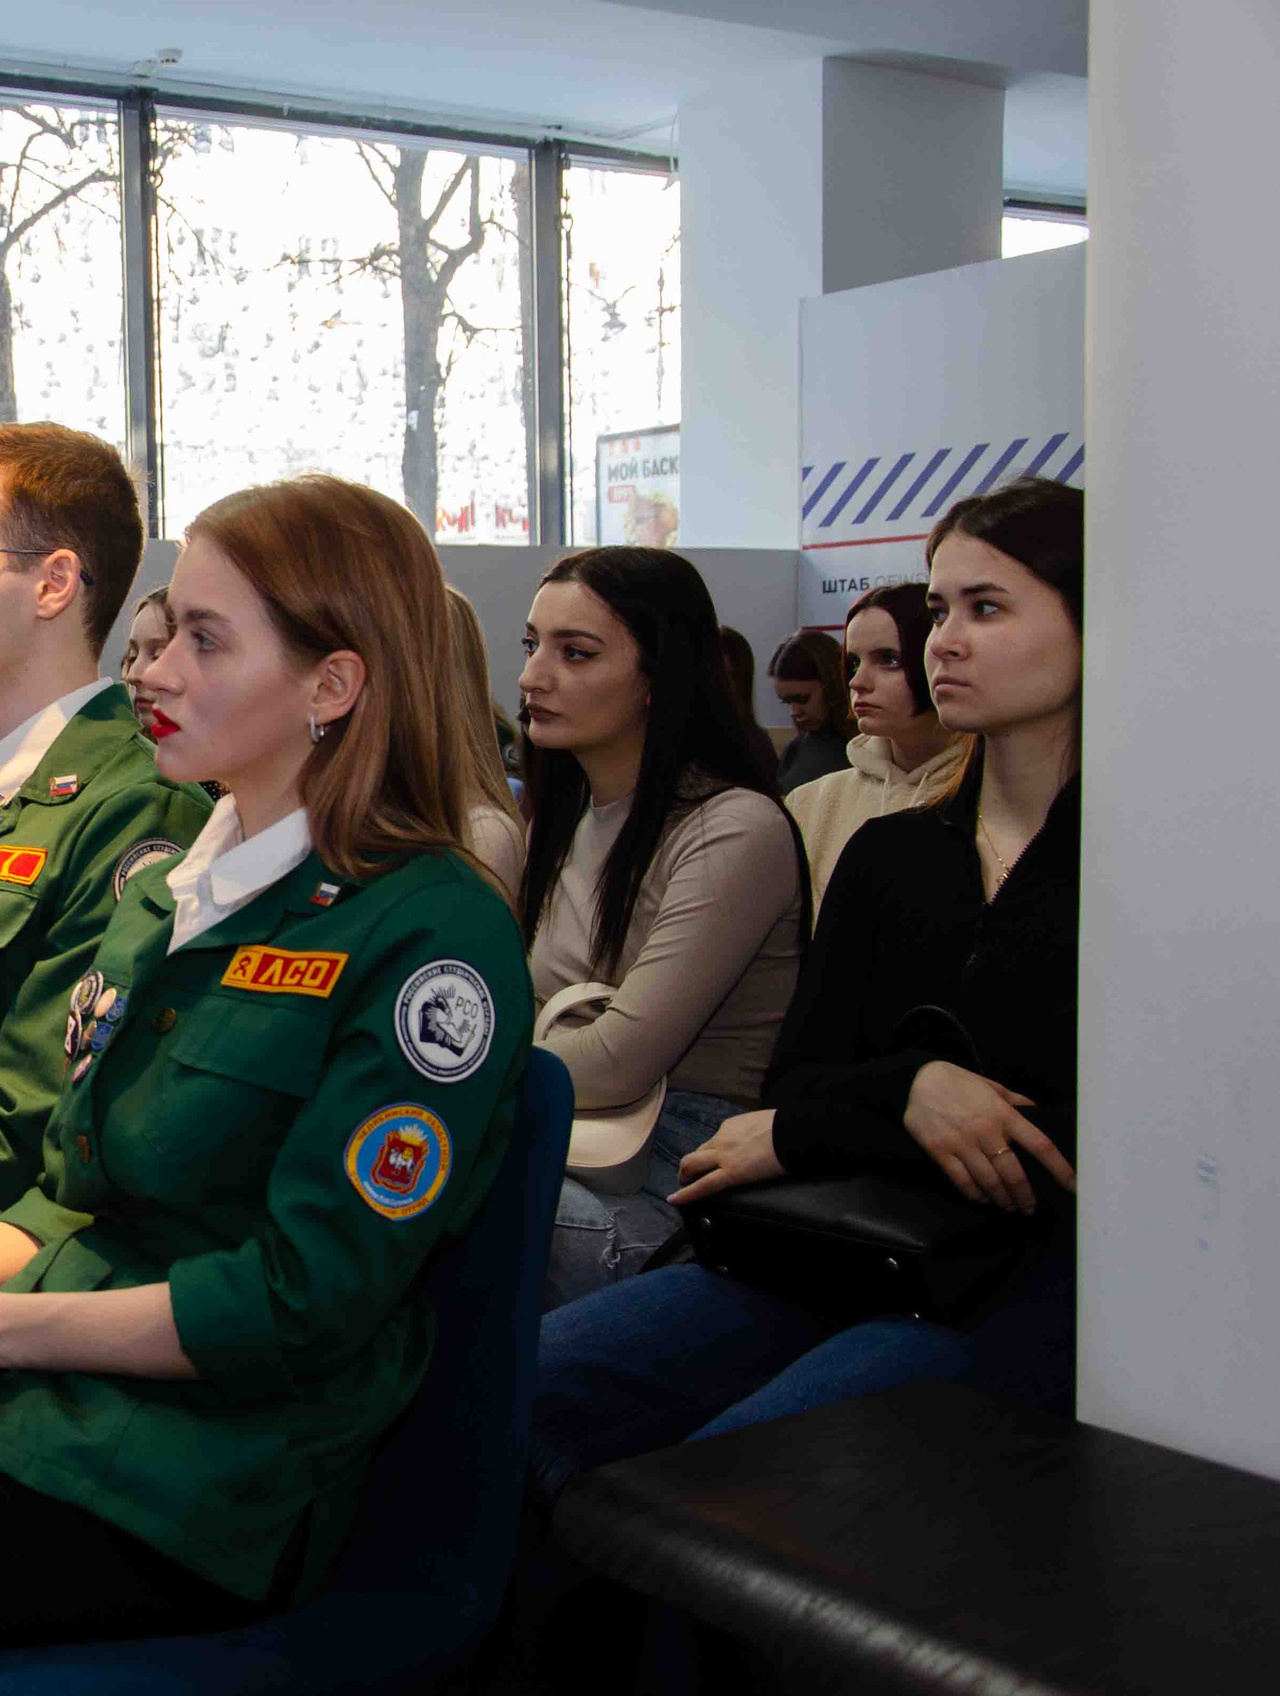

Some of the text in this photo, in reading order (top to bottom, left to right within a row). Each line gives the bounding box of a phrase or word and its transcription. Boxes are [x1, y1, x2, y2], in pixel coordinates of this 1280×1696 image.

[608, 457, 639, 481] МОЙ
[822, 577, 870, 594] ШТАБ
[454, 996, 479, 1019] РСО
